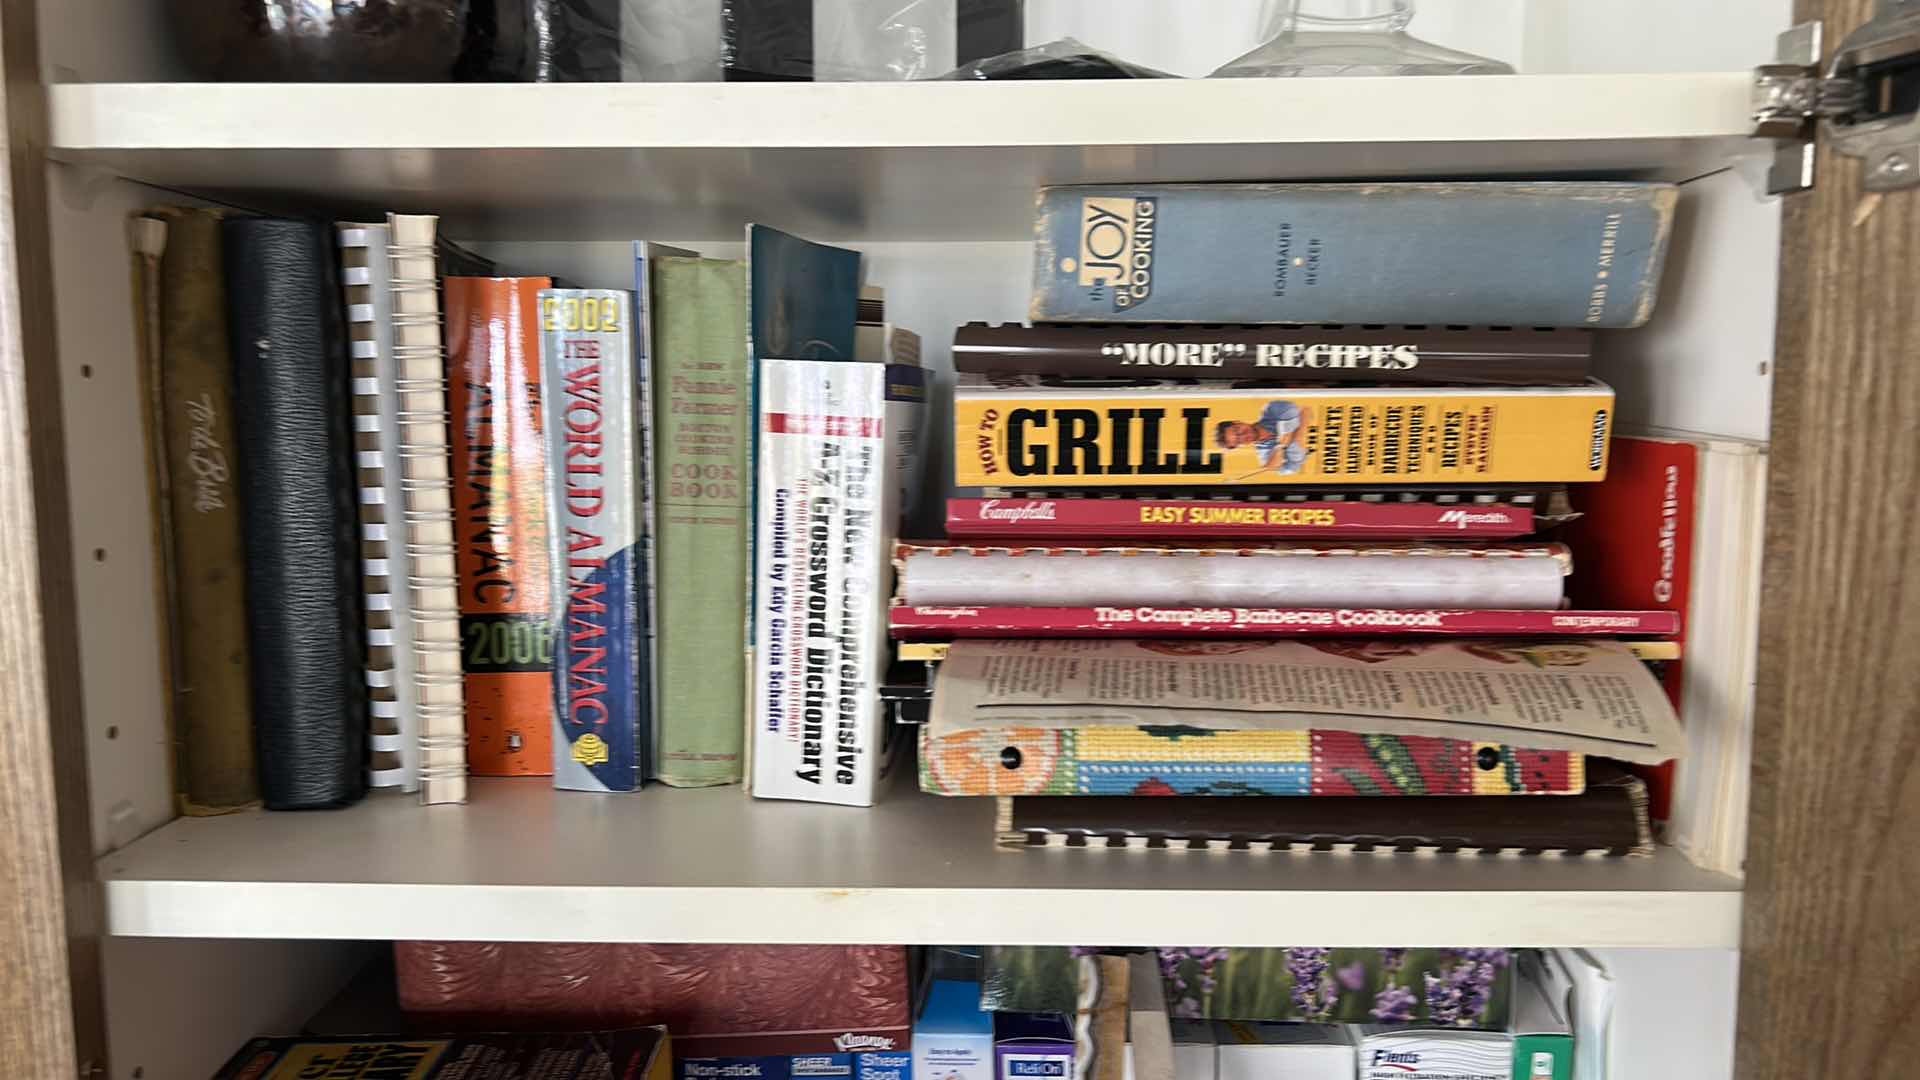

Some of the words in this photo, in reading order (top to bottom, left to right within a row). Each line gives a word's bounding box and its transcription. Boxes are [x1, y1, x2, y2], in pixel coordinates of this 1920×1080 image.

[1085, 204, 1129, 280] JOY
[1114, 285, 1131, 306] OF
[1130, 201, 1154, 299] COOKING
[1272, 222, 1292, 297] ROMBAUER
[1304, 238, 1321, 286] BECKER
[1598, 213, 1621, 268] MERRILL
[1255, 343, 1419, 370] RECIPES
[563, 363, 605, 517] WORLD
[981, 408, 999, 431] TO
[1007, 408, 1223, 476] GRILL
[1307, 426, 1319, 454] THE
[1323, 407, 1343, 473] COMPLETE
[1347, 407, 1363, 473] ILLUSTRATED
[1369, 416, 1378, 429] OF
[1382, 407, 1404, 473] BARBECUE
[1407, 406, 1425, 472] TECHNIQUES
[1427, 426, 1437, 453] AND
[1441, 412, 1463, 467] RECIPES
[1466, 416, 1479, 464] STEVEN
[1590, 411, 1606, 470] WORKMAN
[672, 463, 737, 480] COOK
[977, 434, 998, 475] HOW
[1367, 434, 1376, 466] BOOK
[465, 382, 515, 605] ALMANAC
[672, 482, 737, 498] BOOK
[795, 479, 808, 496] THE
[772, 488, 790, 559] Compiled
[843, 508, 874, 564] New
[1140, 507, 1186, 523] EASY
[1188, 508, 1265, 524] SUMMER
[1267, 508, 1335, 526] RECIPES
[1437, 510, 1512, 529] Meredith
[770, 563, 787, 582] by
[792, 548, 807, 612] BESTSELLING
[807, 497, 838, 638] Crossword
[566, 526, 609, 725] ALMANAC
[769, 586, 787, 613] Edy
[1094, 607, 1133, 622] The
[1135, 608, 1233, 626] Complete
[1234, 608, 1334, 625] Barbecue
[1335, 609, 1443, 627] Cookbook
[469, 619, 552, 665] 2006
[770, 618, 787, 666] Garcia
[790, 616, 805, 676] CROSSWORD
[768, 671, 785, 733] Schaffer
[836, 576, 868, 785] Comprehensive
[795, 647, 835, 785] Dictionary
[684, 1063, 762, 1077] Non-stick
[859, 1053, 911, 1068] Sheer
